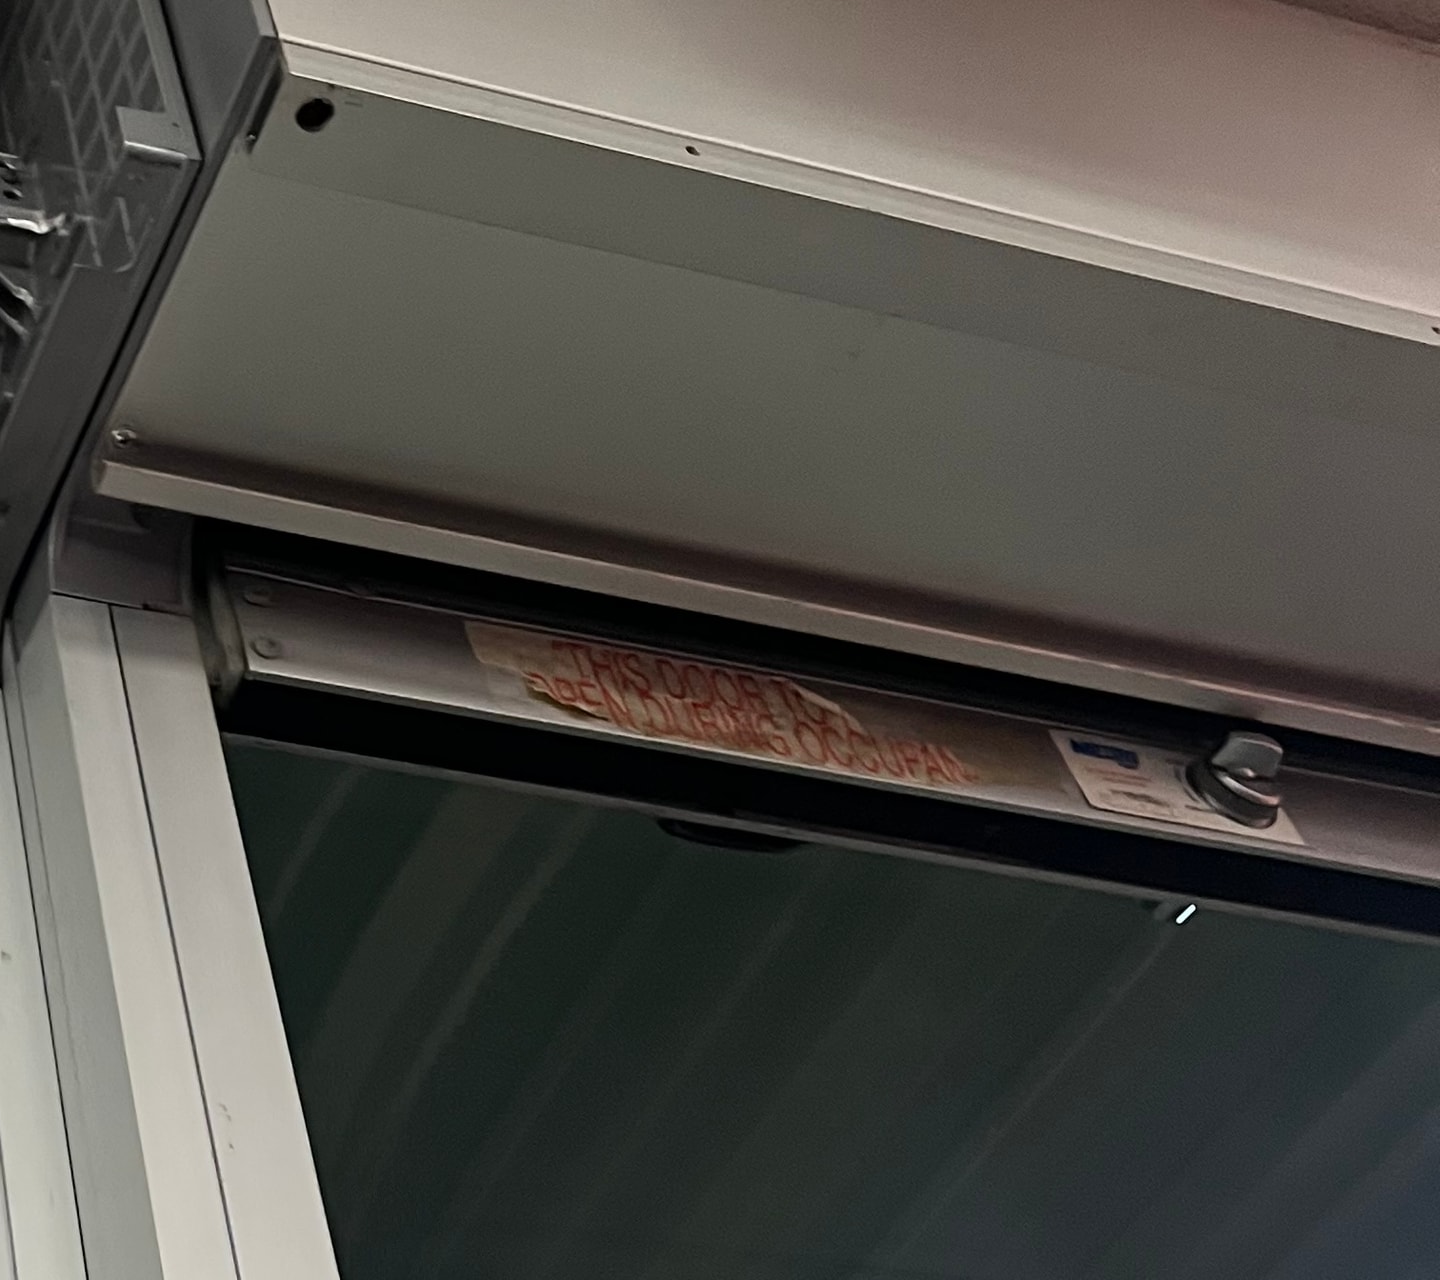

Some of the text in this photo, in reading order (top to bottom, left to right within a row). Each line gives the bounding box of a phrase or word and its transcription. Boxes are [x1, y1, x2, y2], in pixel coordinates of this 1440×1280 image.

[551, 639, 652, 698] THIS
[655, 658, 779, 730] DOOR
[640, 690, 791, 757] DURING
